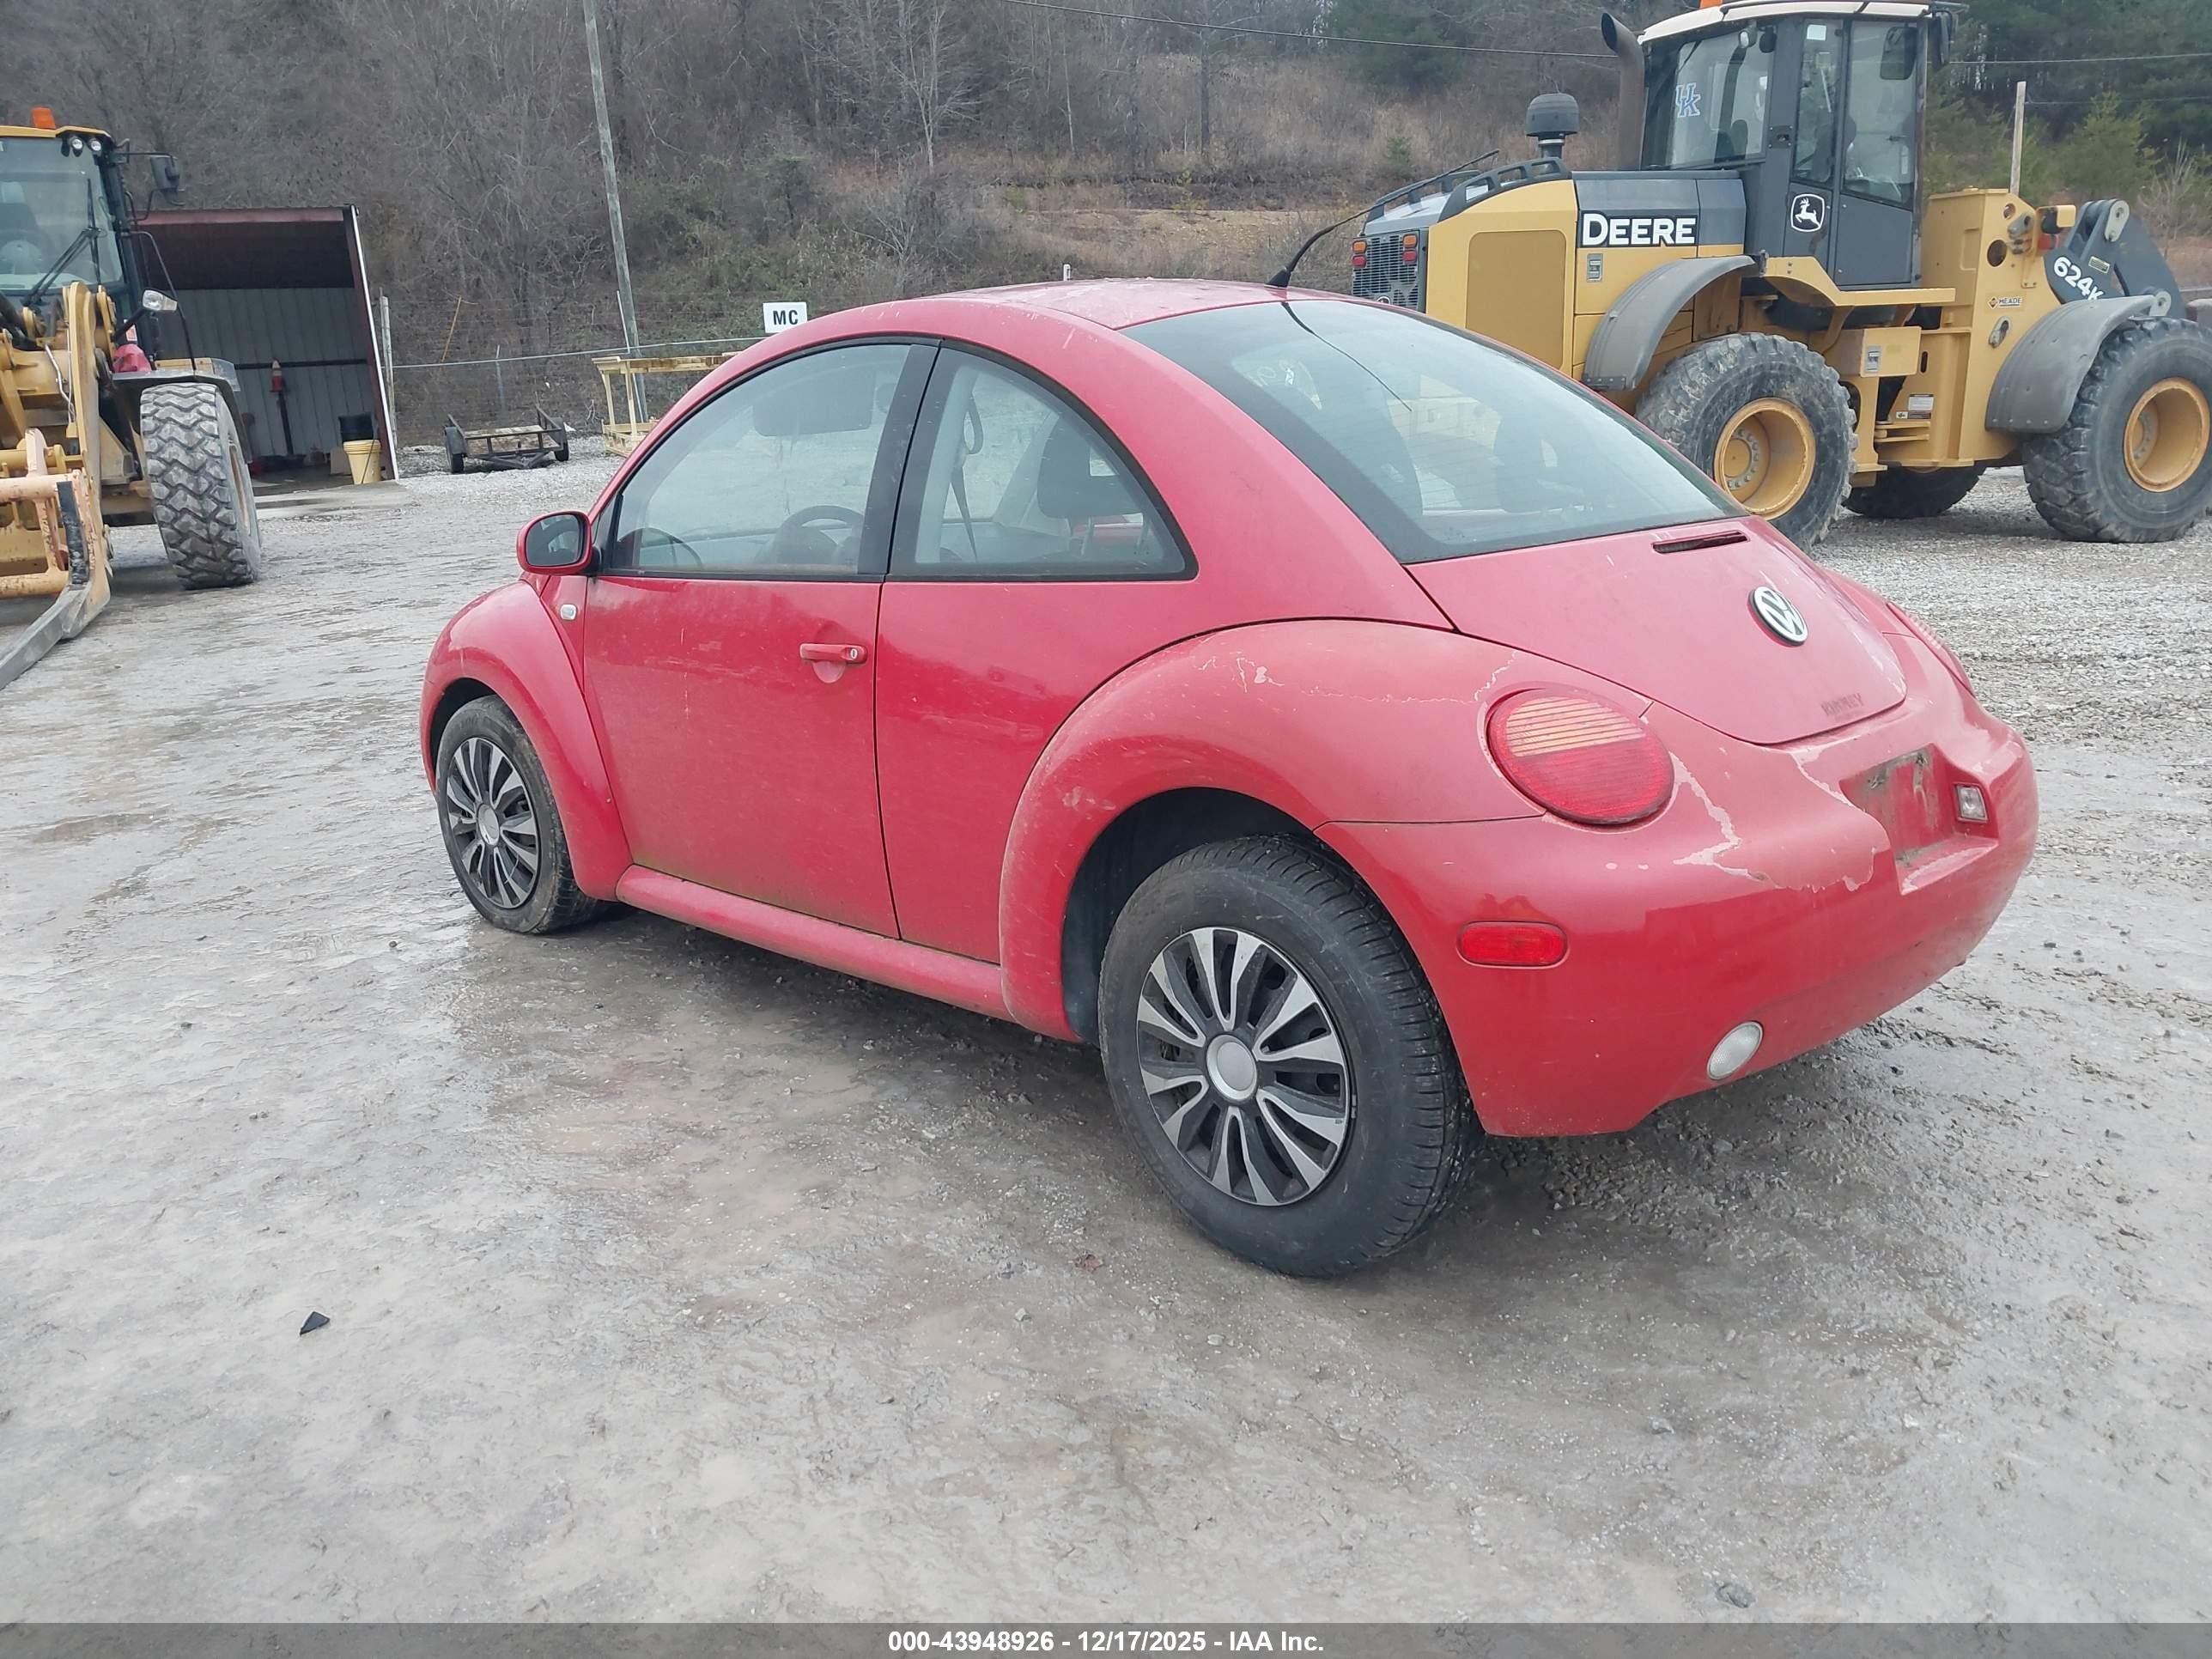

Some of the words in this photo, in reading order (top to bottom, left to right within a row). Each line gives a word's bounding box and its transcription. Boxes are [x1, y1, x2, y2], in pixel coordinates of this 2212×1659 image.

[1675, 82, 1701, 118] UK
[1582, 213, 1696, 246] DEERE
[2053, 257, 2104, 301] 624K
[773, 310, 799, 325] MC
